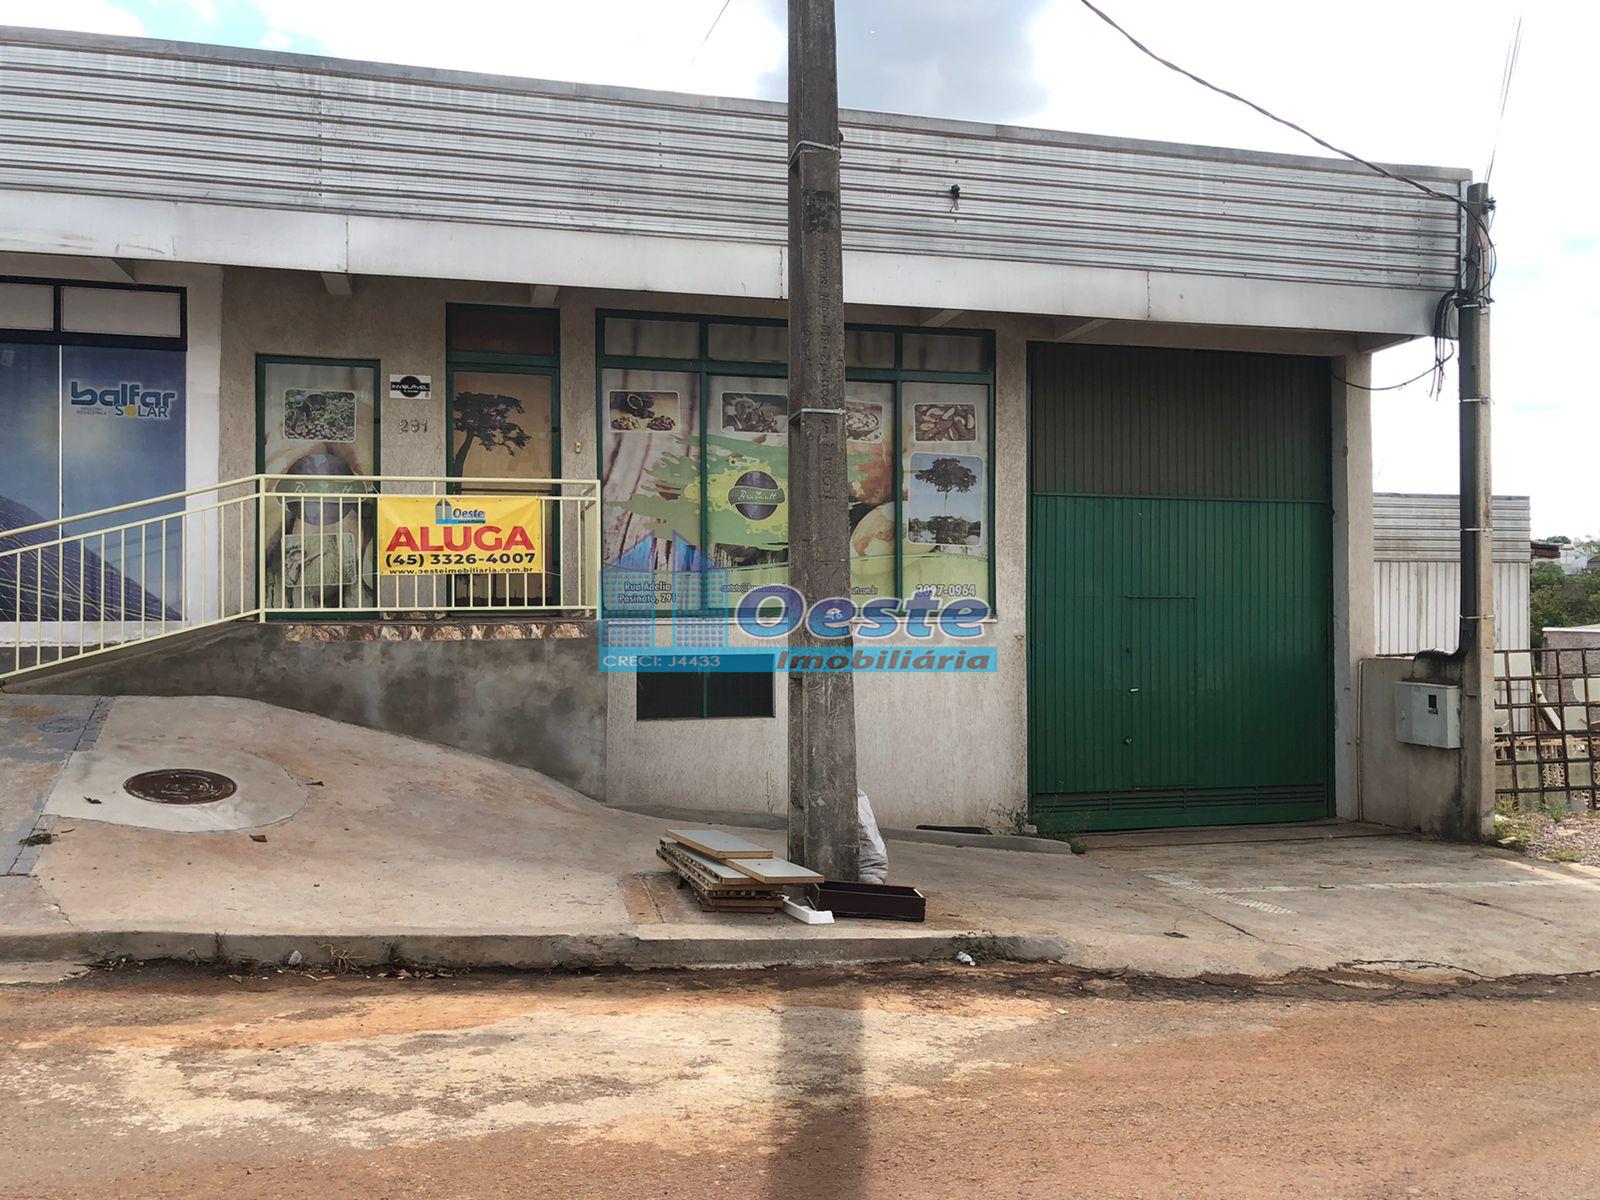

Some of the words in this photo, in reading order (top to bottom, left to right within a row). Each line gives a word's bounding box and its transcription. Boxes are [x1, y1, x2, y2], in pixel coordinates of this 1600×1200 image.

[71, 381, 176, 409] balfar
[114, 404, 169, 418] SOLAR
[452, 508, 486, 519] Oeste
[385, 525, 536, 552] ALUGA
[385, 553, 425, 568] (45)
[450, 552, 536, 565] 3326-4007
[389, 566, 534, 575] www.oesteimobiliaria.com.br
